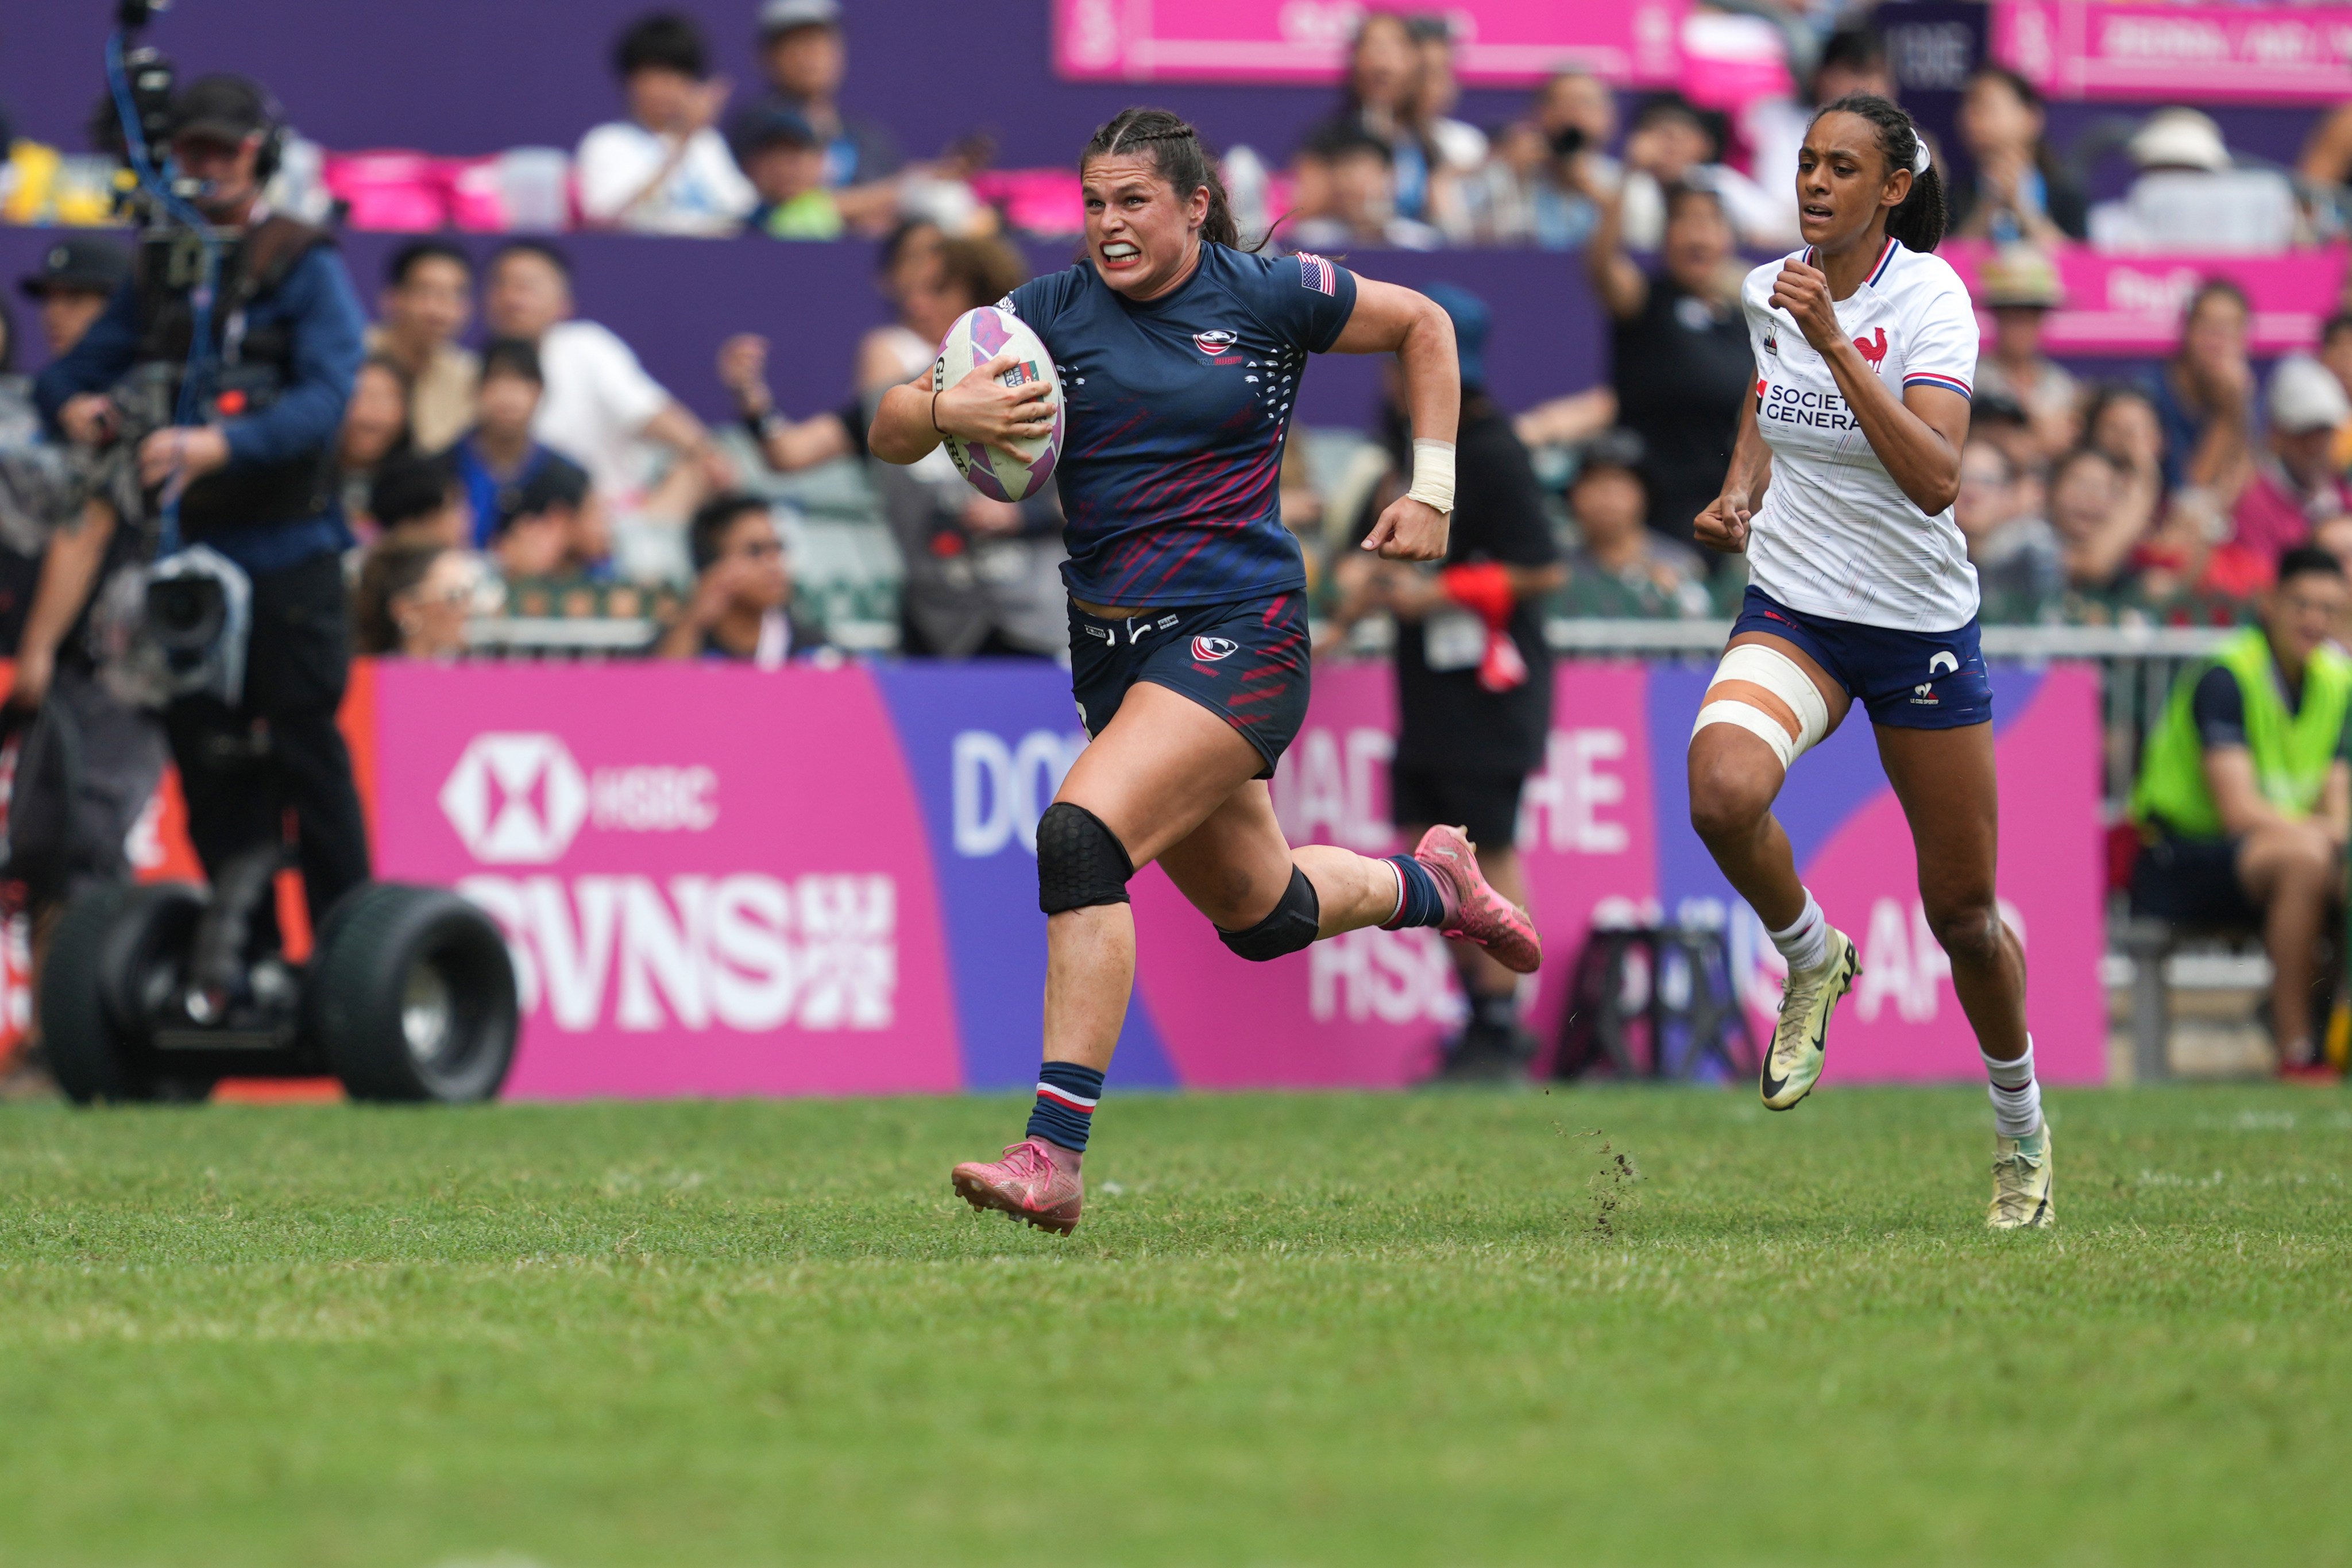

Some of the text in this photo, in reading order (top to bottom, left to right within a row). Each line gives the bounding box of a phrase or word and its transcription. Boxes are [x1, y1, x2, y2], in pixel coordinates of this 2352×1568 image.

[1214, 356, 1243, 366] RUGBY
[1005, 369, 1017, 387] SEV
[1770, 385, 1848, 411] SOCIET
[591, 764, 719, 832] HSBC
